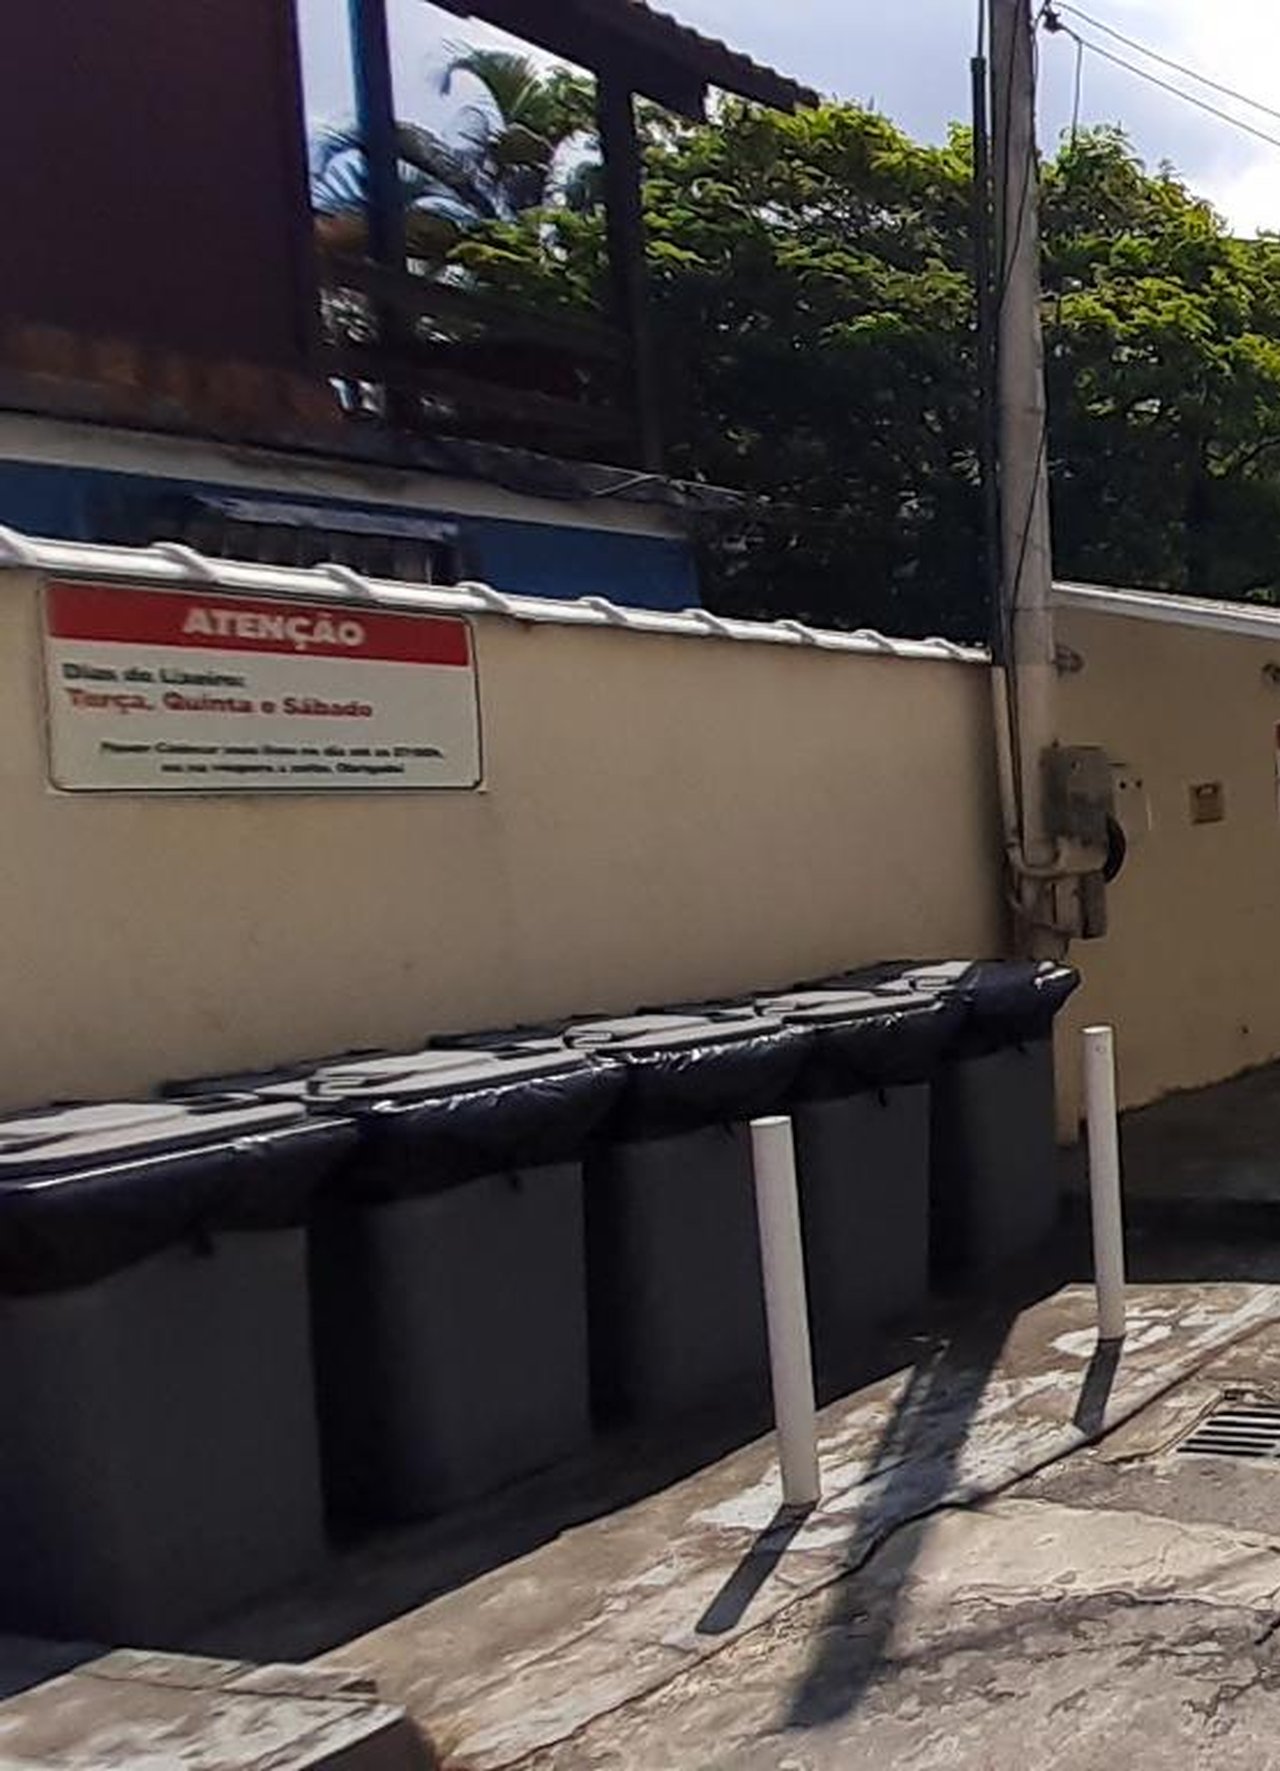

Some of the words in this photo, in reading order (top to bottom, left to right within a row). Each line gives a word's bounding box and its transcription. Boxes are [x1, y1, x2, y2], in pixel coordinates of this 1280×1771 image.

[182, 607, 366, 651] ATENÇÃO
[163, 691, 254, 713] Quinta
[261, 701, 276, 714] e
[282, 697, 373, 717] Sábado
